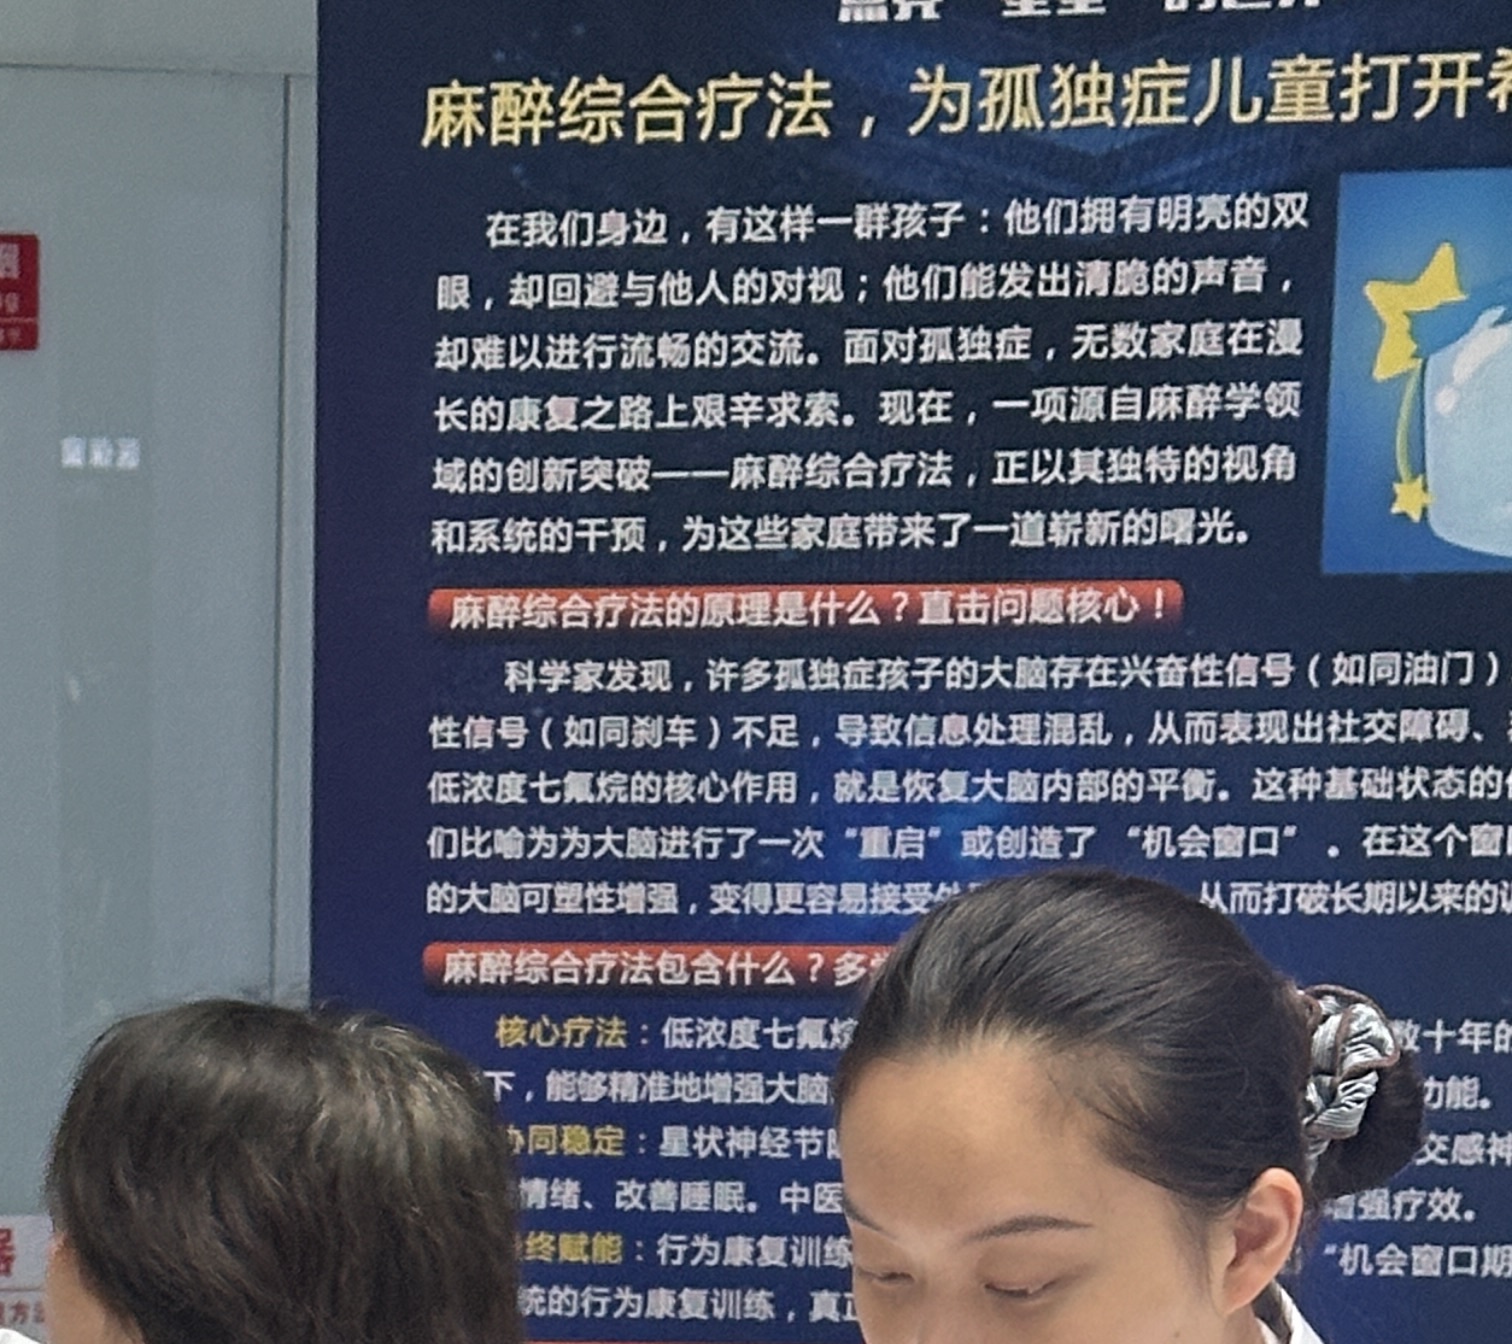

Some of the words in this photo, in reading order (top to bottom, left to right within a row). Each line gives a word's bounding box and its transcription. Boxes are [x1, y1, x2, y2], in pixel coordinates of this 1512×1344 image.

[486, 191, 1309, 249] 在我们身边，有这样一群孩子：他们拥有明亮的双
[437, 257, 1292, 311] 眼，却回避与他人的对视；他们能发出清脆的声音，
[434, 319, 1303, 371] 却难以进行流畅的交流。面对孤独症，无数家庭在漫
[434, 381, 1301, 432] 长的康复之路上艰辛求索。现在，一项源自麻醉学领
[431, 507, 1249, 554] 和系统的干预，为这些家庭带来了一道崭新的曙光。
[450, 586, 1166, 630] 麻醉综合疗法的原理是什么？直击问题核心！
[428, 708, 1512, 750] 性信号（如同刹车）不足，导致信息处理混乱，从而表现出社交障碍、
[427, 766, 1512, 804] 低浓度七氟烷的核心作用，就是恢复大脑内部的平衡。这种基础状态的
[427, 823, 1512, 860] 们比喻为为大脑进行了一次“重启”或创造了“机会窗口”。在这个窗
[484, 1069, 835, 1105] 下，能够精准地增强大脑
[514, 1231, 853, 1269] 终赋能：行为康复训练
